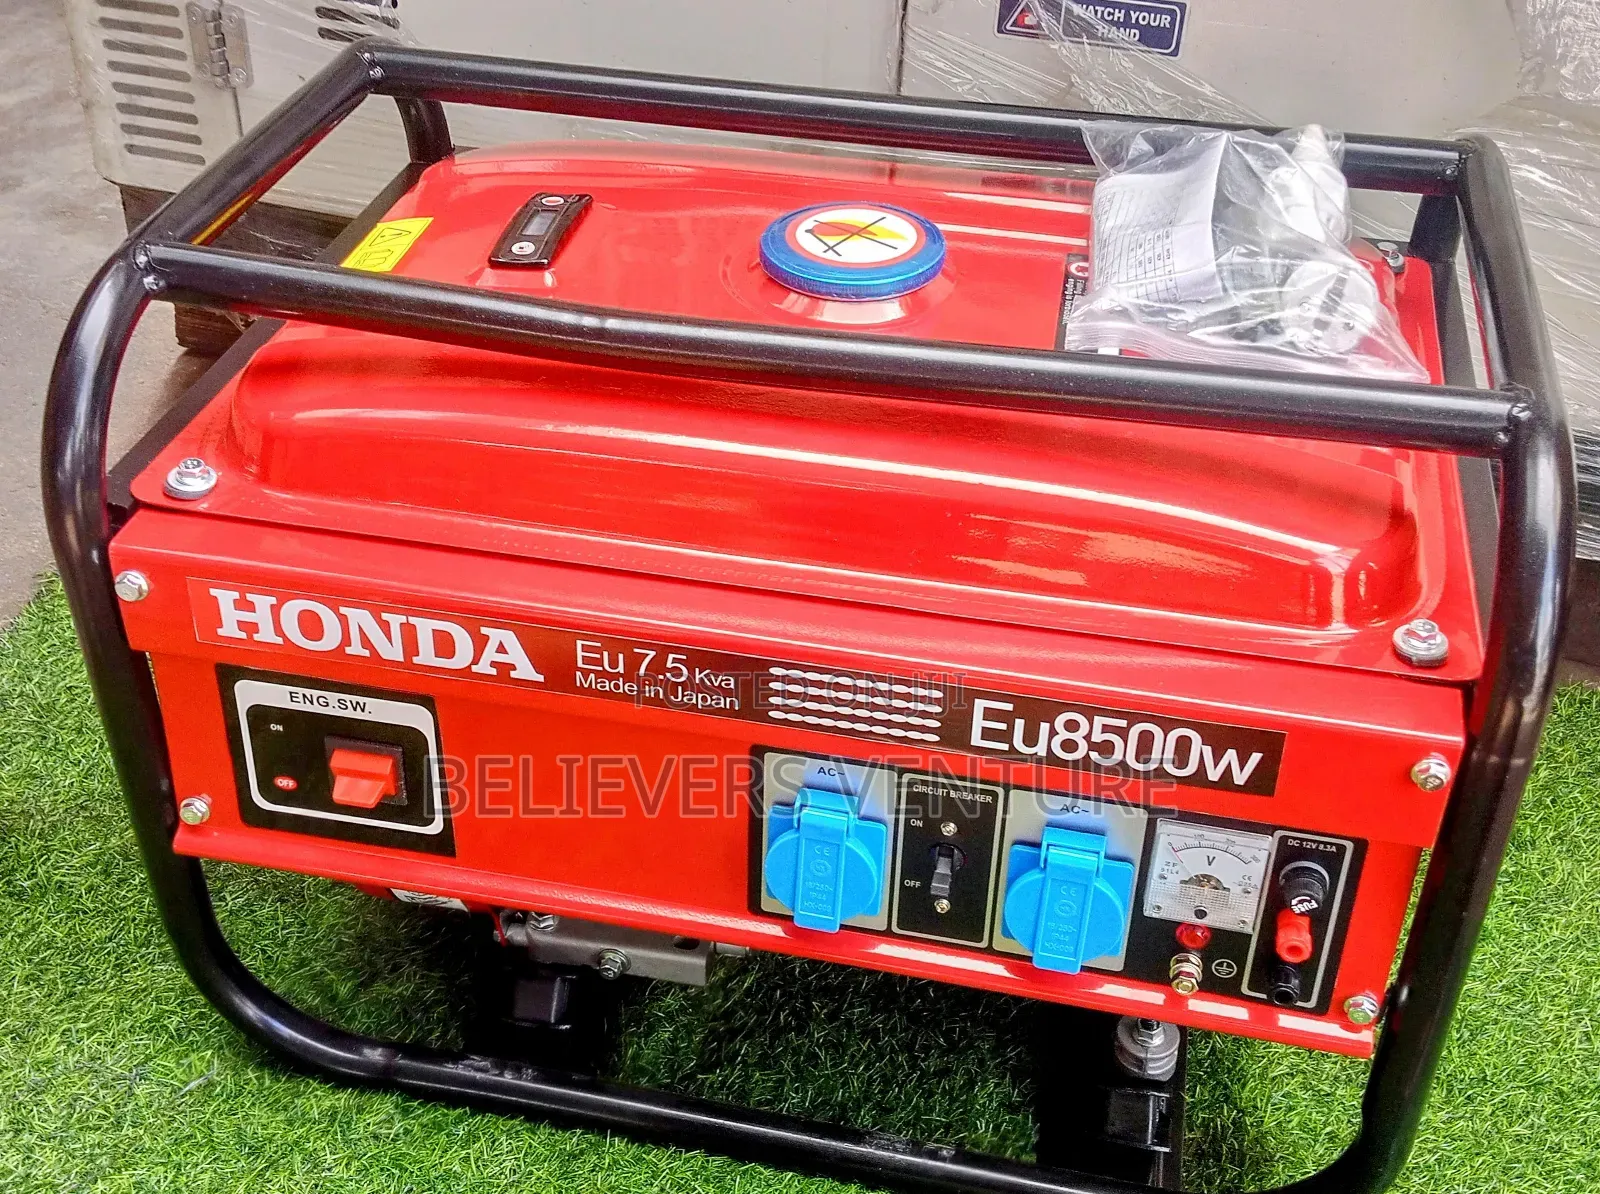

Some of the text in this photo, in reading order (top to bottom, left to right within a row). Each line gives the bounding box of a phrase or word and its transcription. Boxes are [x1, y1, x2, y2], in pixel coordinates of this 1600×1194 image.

[1130, 10, 1171, 28] YOUR
[1096, 25, 1140, 41] HAND
[208, 587, 545, 683] HONDA
[575, 639, 736, 690] Eu 7.5 Kva
[575, 671, 740, 711] Made in Japan
[288, 691, 373, 714] ENG.SW.
[270, 723, 283, 732] ON
[969, 698, 1264, 786] Eu8500w
[277, 778, 295, 788] OFF
[912, 784, 993, 804] CIRCUIT BREAKER
[910, 818, 923, 828] ON
[1287, 839, 1337, 853] DC 12V 8.3A
[1206, 855, 1216, 866] V
[904, 879, 921, 888] OFF
[1291, 899, 1319, 914] FUSE
